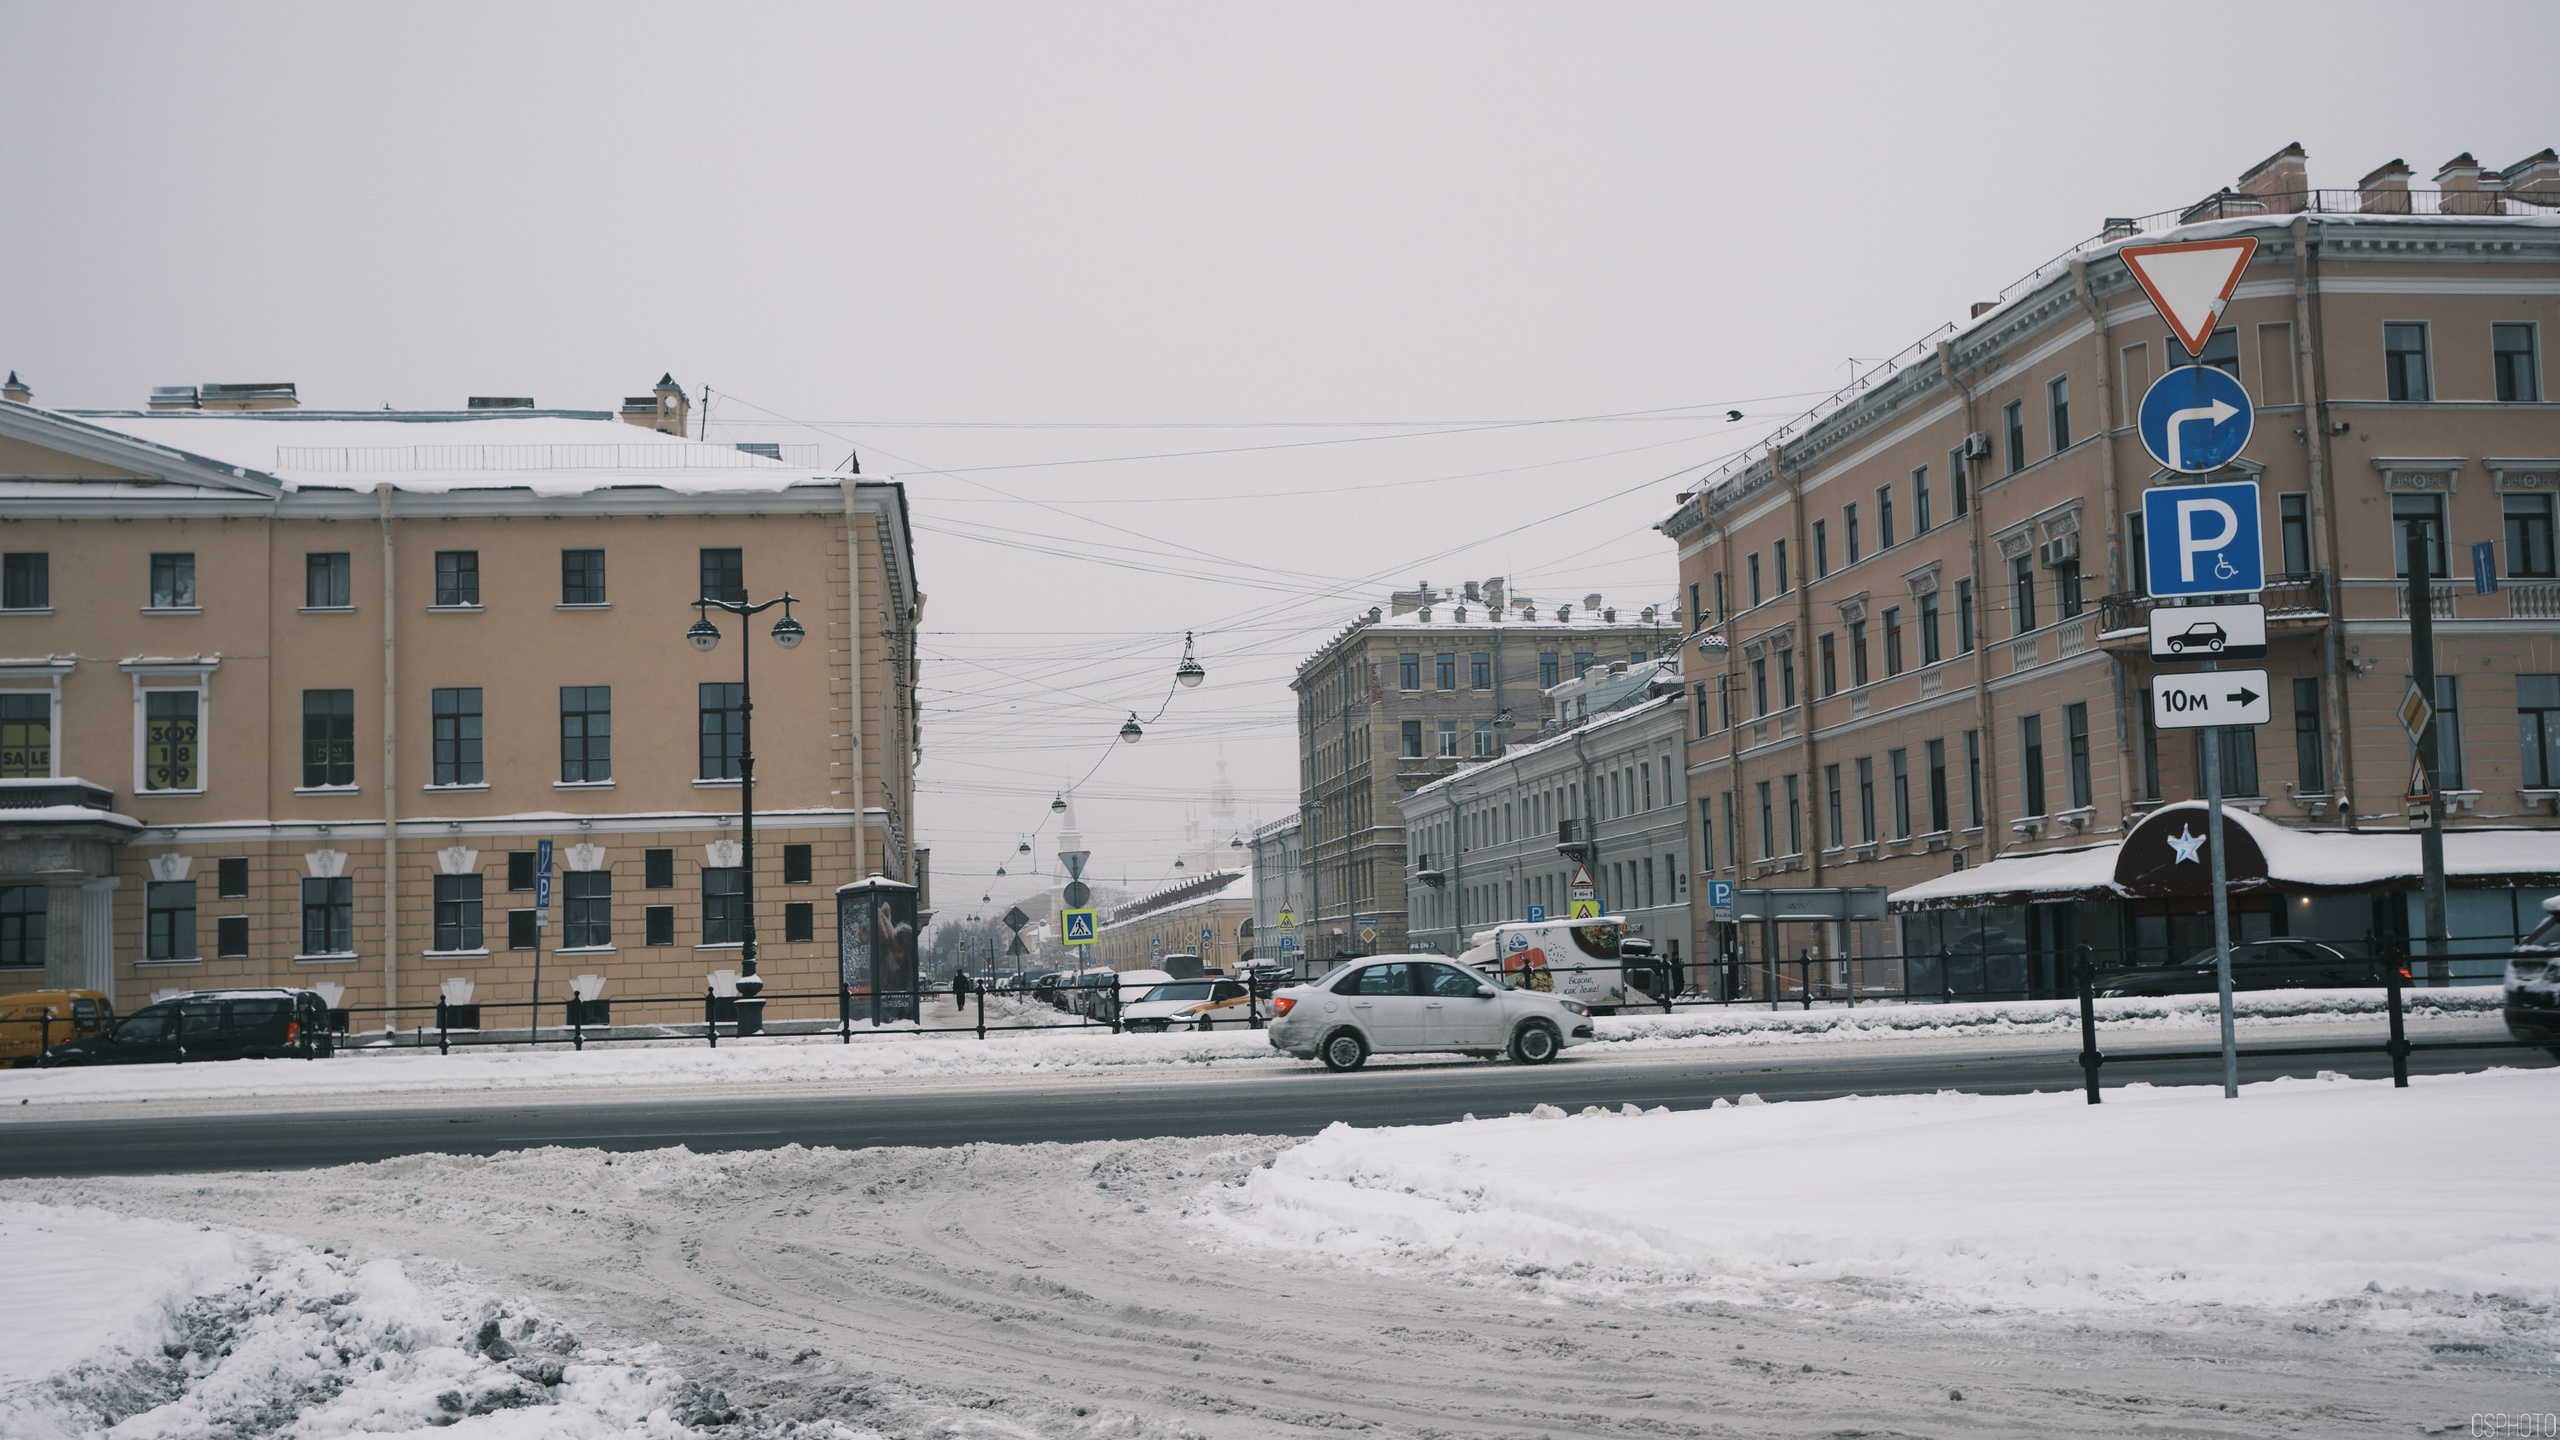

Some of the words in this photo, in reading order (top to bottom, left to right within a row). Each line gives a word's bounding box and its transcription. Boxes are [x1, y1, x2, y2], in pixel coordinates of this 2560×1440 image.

[2176, 498, 2239, 583] P
[3, 751, 48, 765] SALE
[1715, 883, 1730, 904] P
